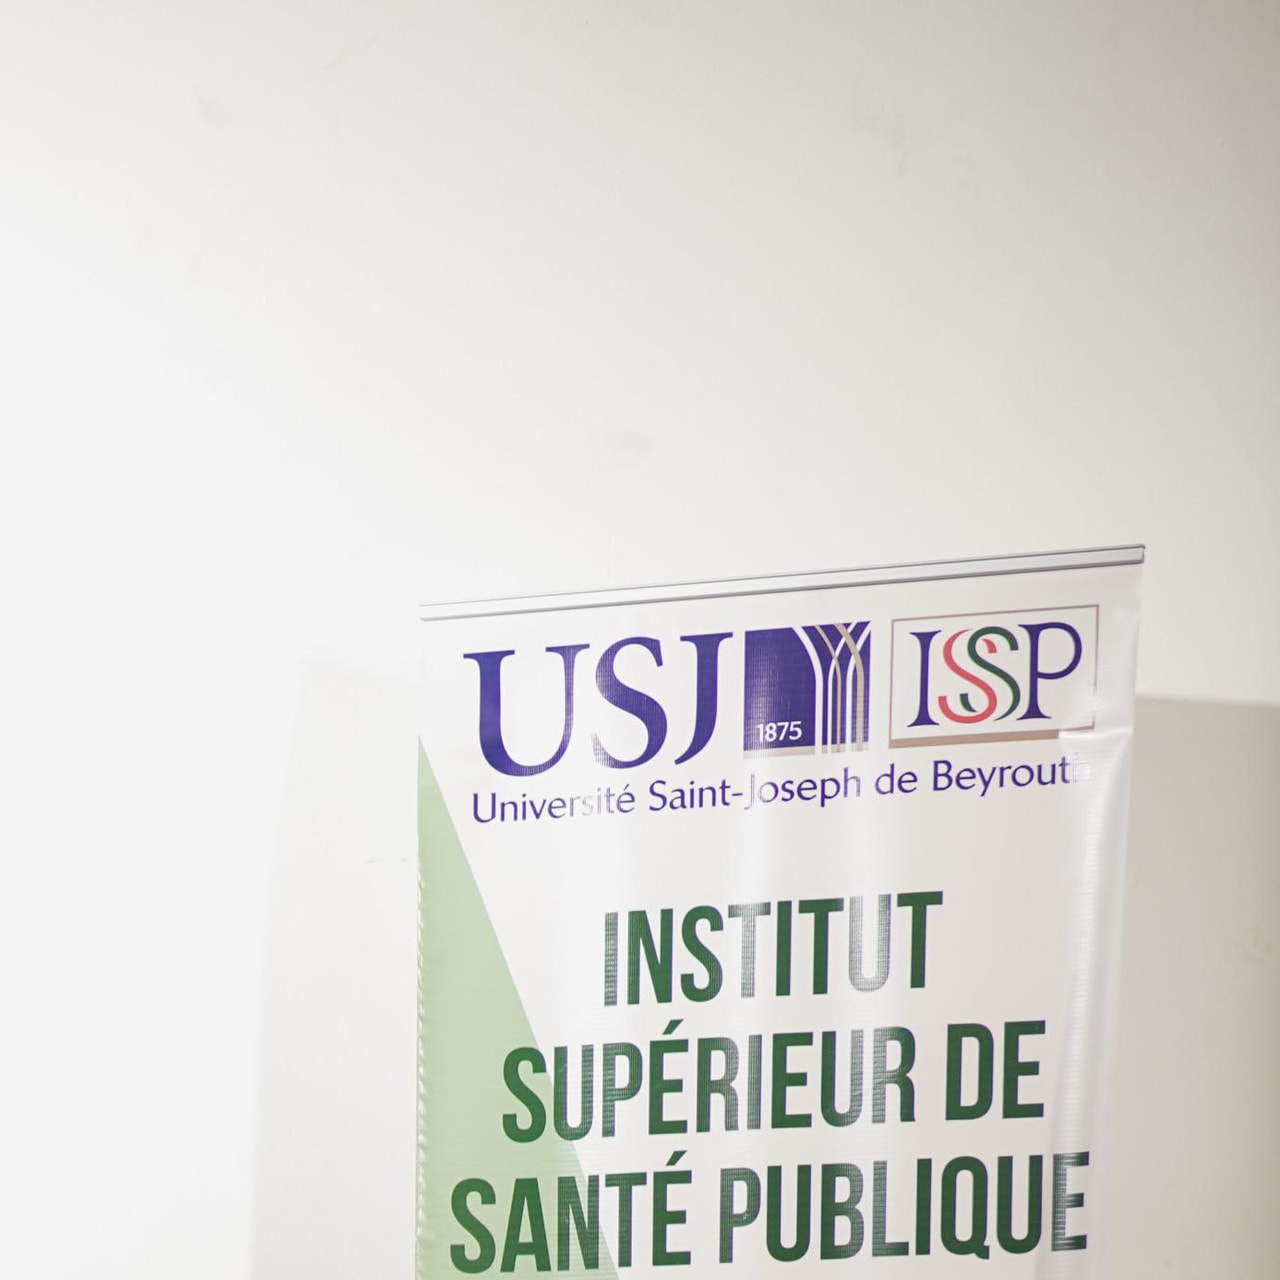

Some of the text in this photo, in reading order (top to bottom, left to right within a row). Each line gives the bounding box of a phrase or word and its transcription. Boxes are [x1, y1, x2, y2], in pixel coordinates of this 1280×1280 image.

[462, 631, 734, 777] USJ
[906, 621, 1083, 724] ISSP
[755, 720, 803, 743] 1875
[472, 783, 636, 823] Université
[648, 767, 862, 811] Saint-Joseph
[874, 763, 919, 795] de
[603, 890, 944, 1007] INSTITUT
[501, 1018, 1047, 1144] SUPÉRIEUR DE
[449, 1150, 1090, 1274] SANTÉ PUBLIQUE
